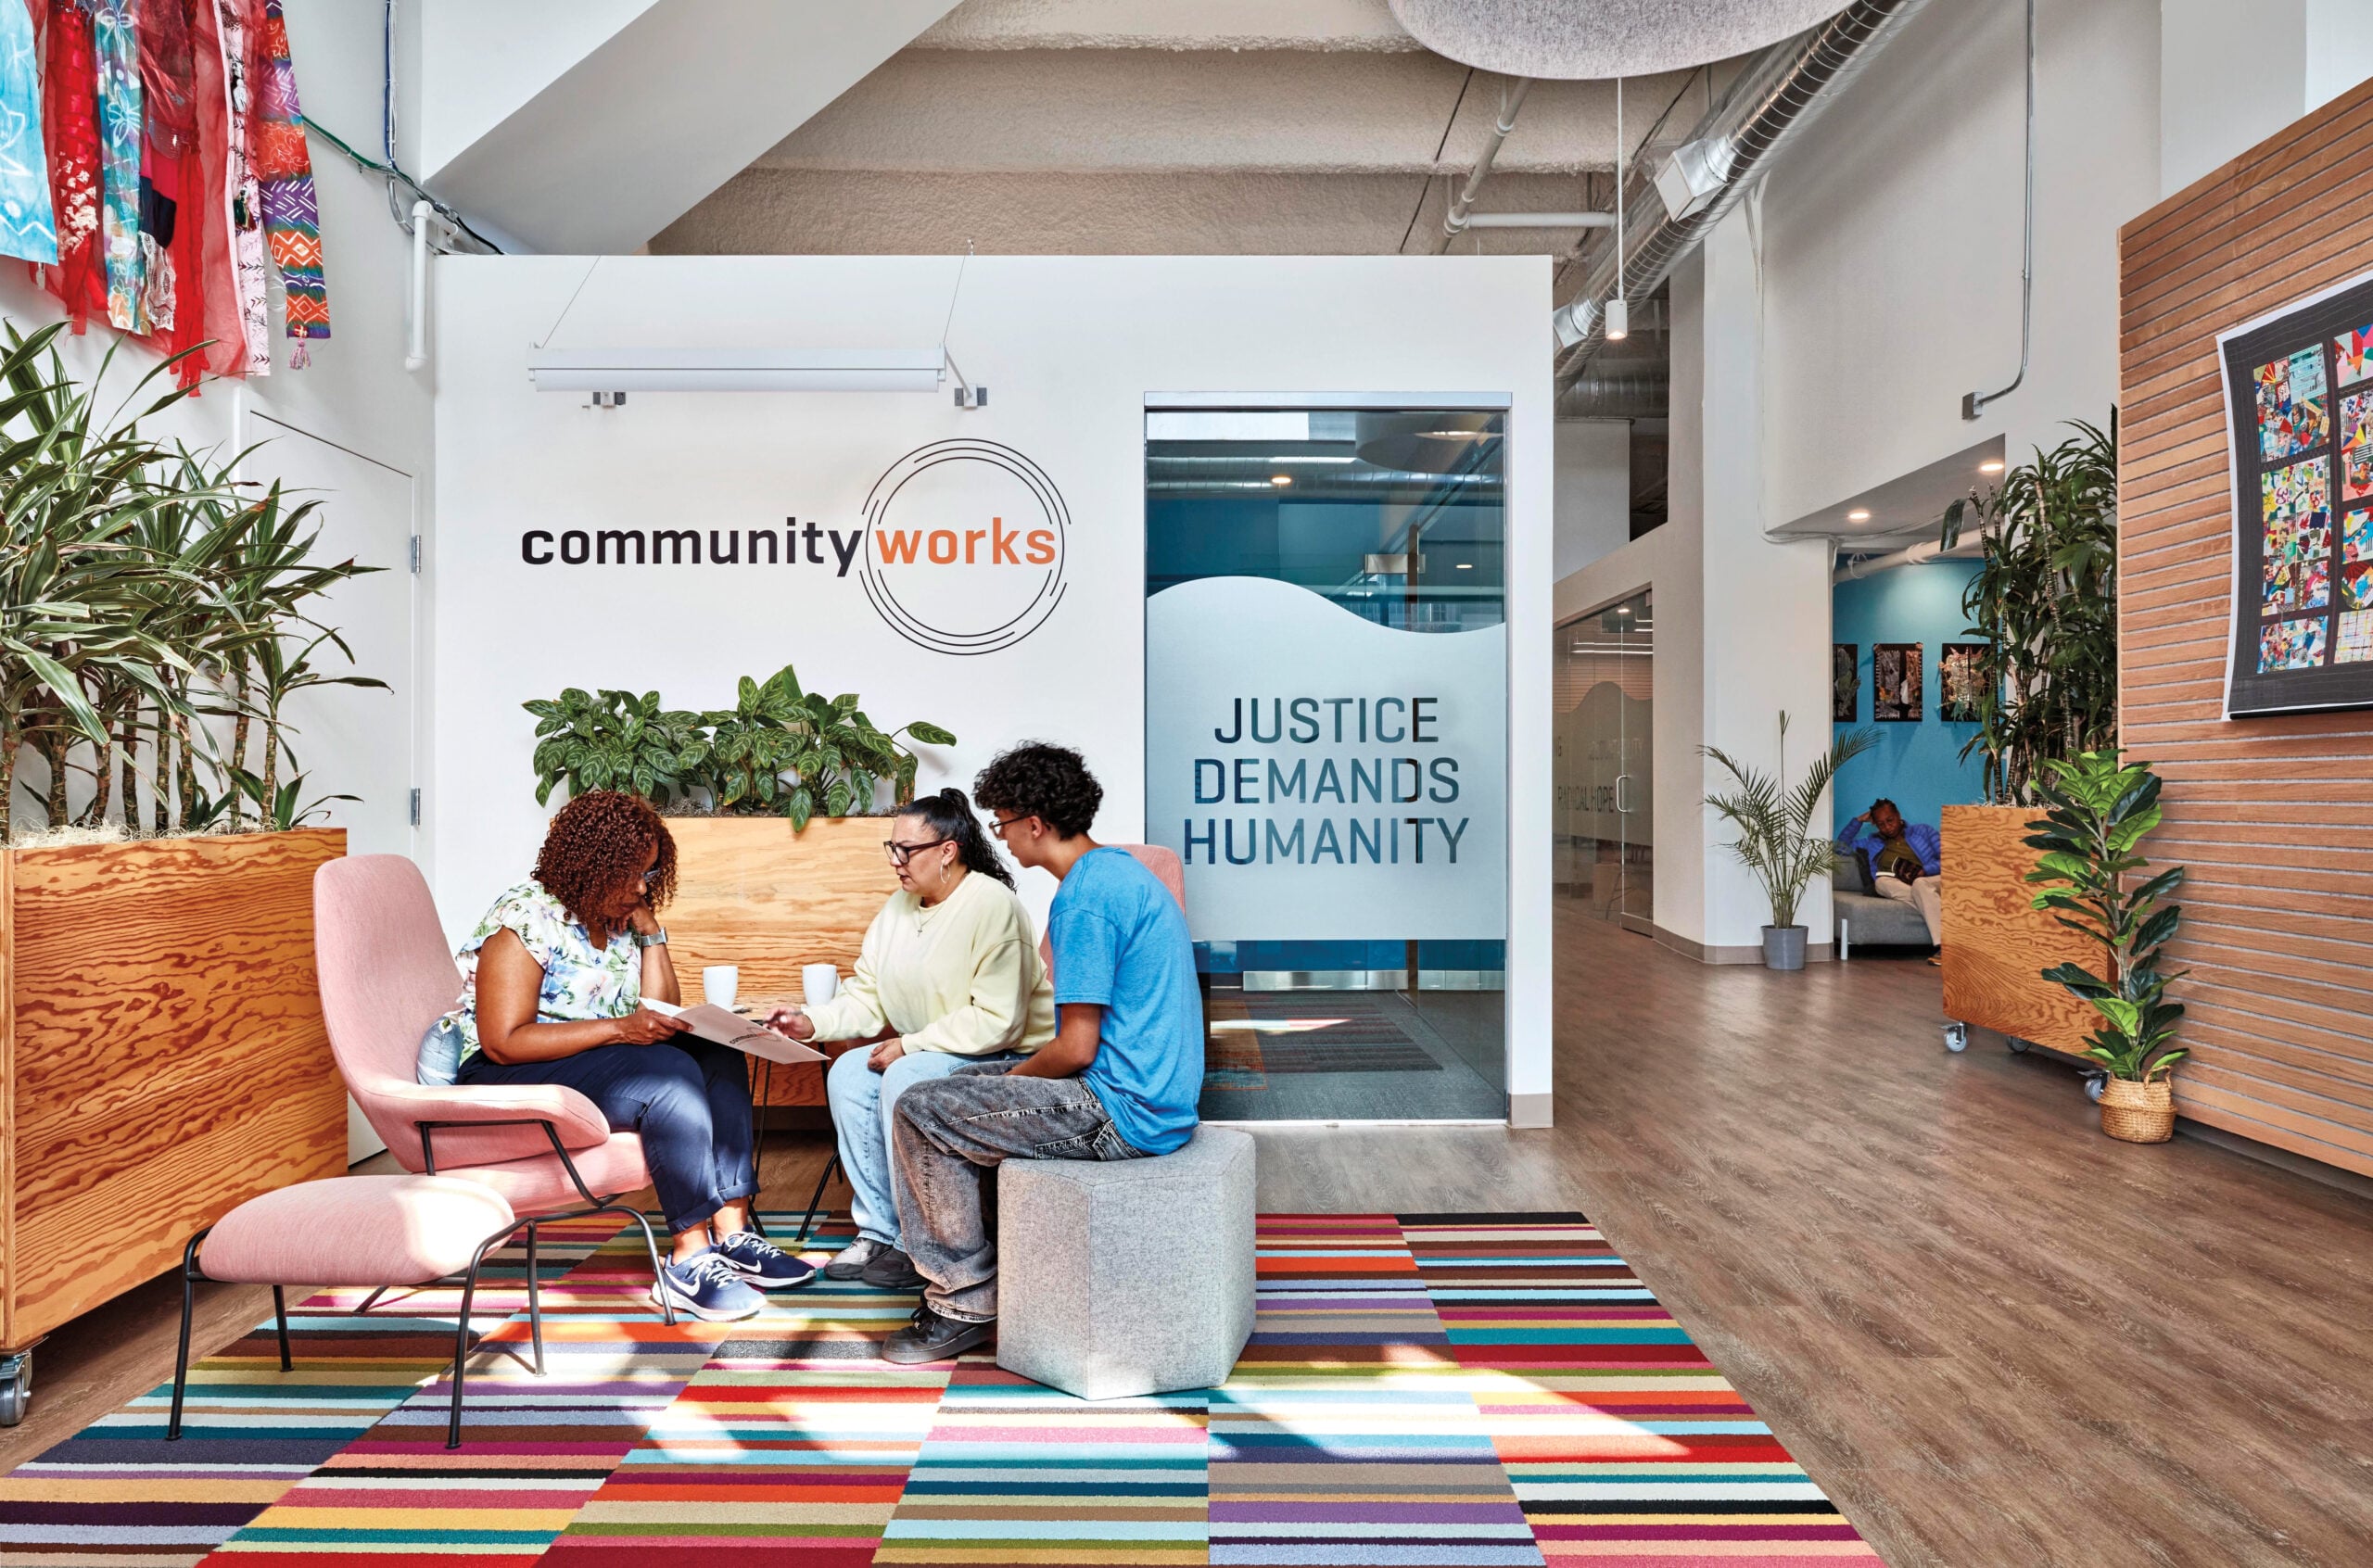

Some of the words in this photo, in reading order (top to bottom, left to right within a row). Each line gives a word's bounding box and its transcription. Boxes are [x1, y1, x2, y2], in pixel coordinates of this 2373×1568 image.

[521, 517, 863, 577] community
[875, 517, 1056, 564] works
[1214, 697, 1440, 743] JUSTICE
[1194, 757, 1460, 803] DEMANDS
[1591, 786, 1615, 813] HOPE
[1183, 817, 1469, 865] HUMANITY
